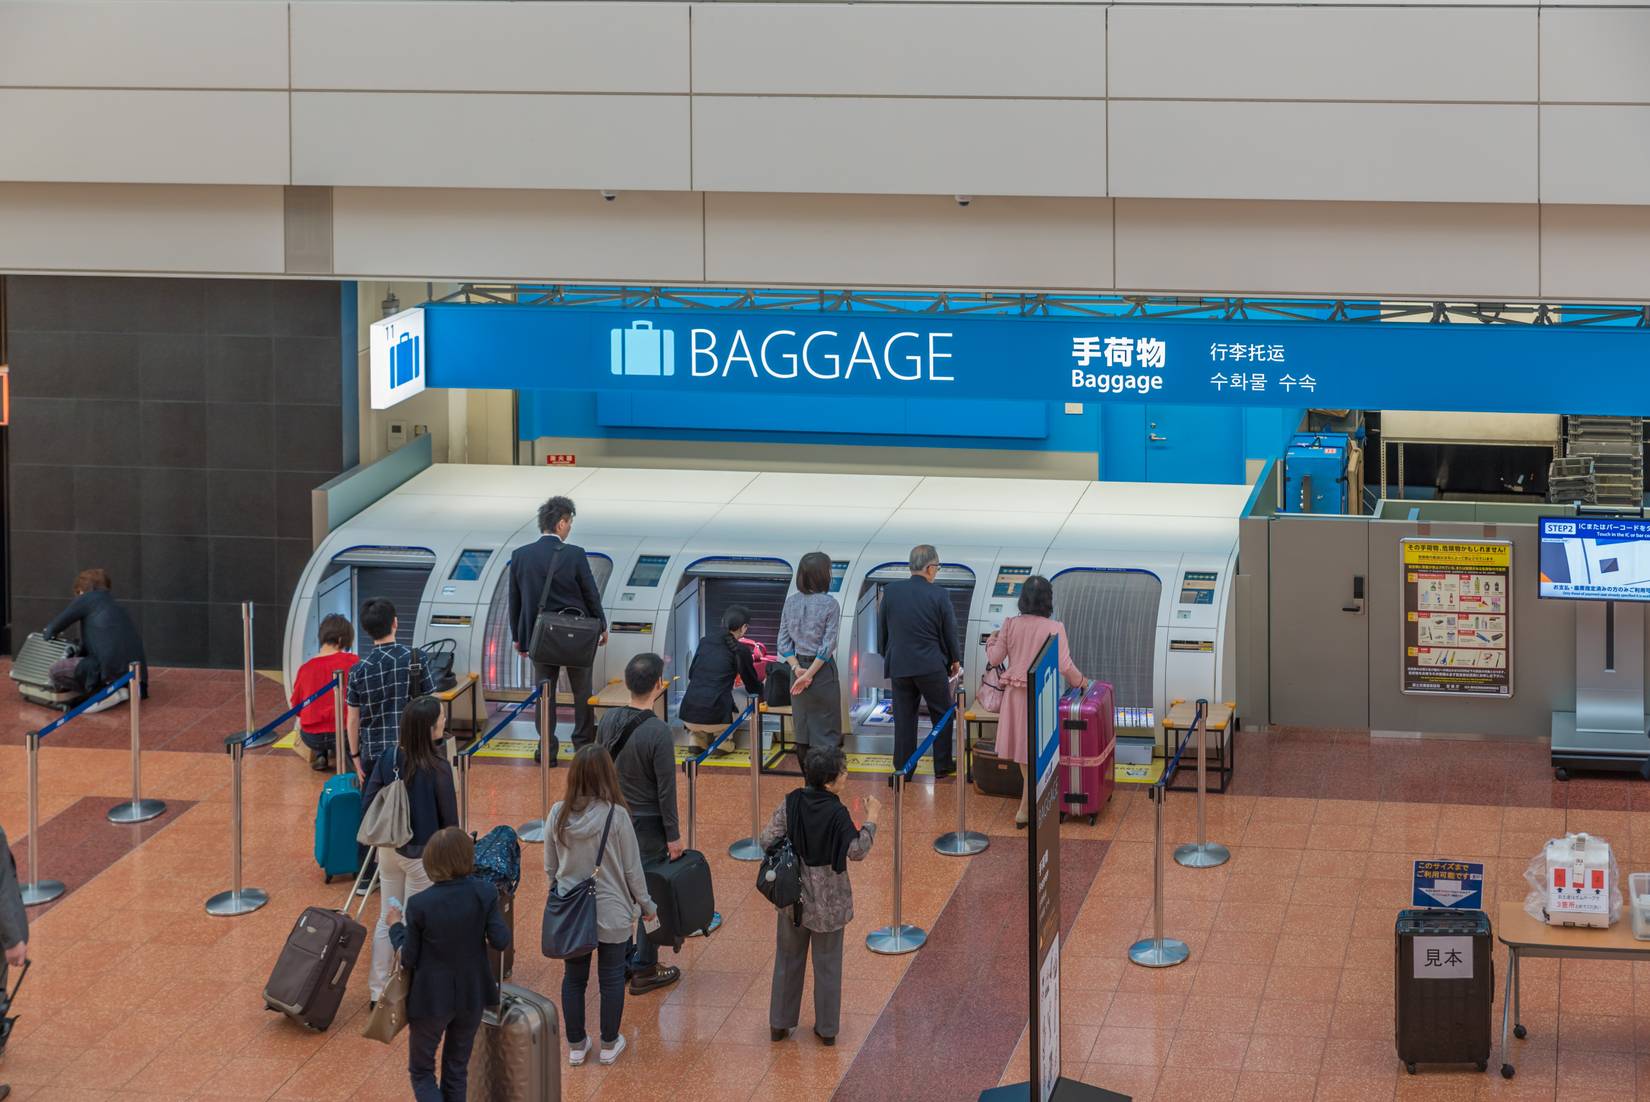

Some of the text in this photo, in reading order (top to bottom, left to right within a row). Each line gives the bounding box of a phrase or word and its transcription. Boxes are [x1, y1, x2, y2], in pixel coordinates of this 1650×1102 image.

[690, 328, 956, 381] BAGGAGE
[1072, 336, 1166, 368] 手荷物
[1210, 342, 1285, 362] 行李托运
[1071, 370, 1163, 394] Baggage
[1210, 372, 1317, 393] 수화물 수속
[1547, 524, 1574, 534] STEP2
[1418, 862, 1469, 871] このサイズまで
[1424, 948, 1463, 967] 見本
